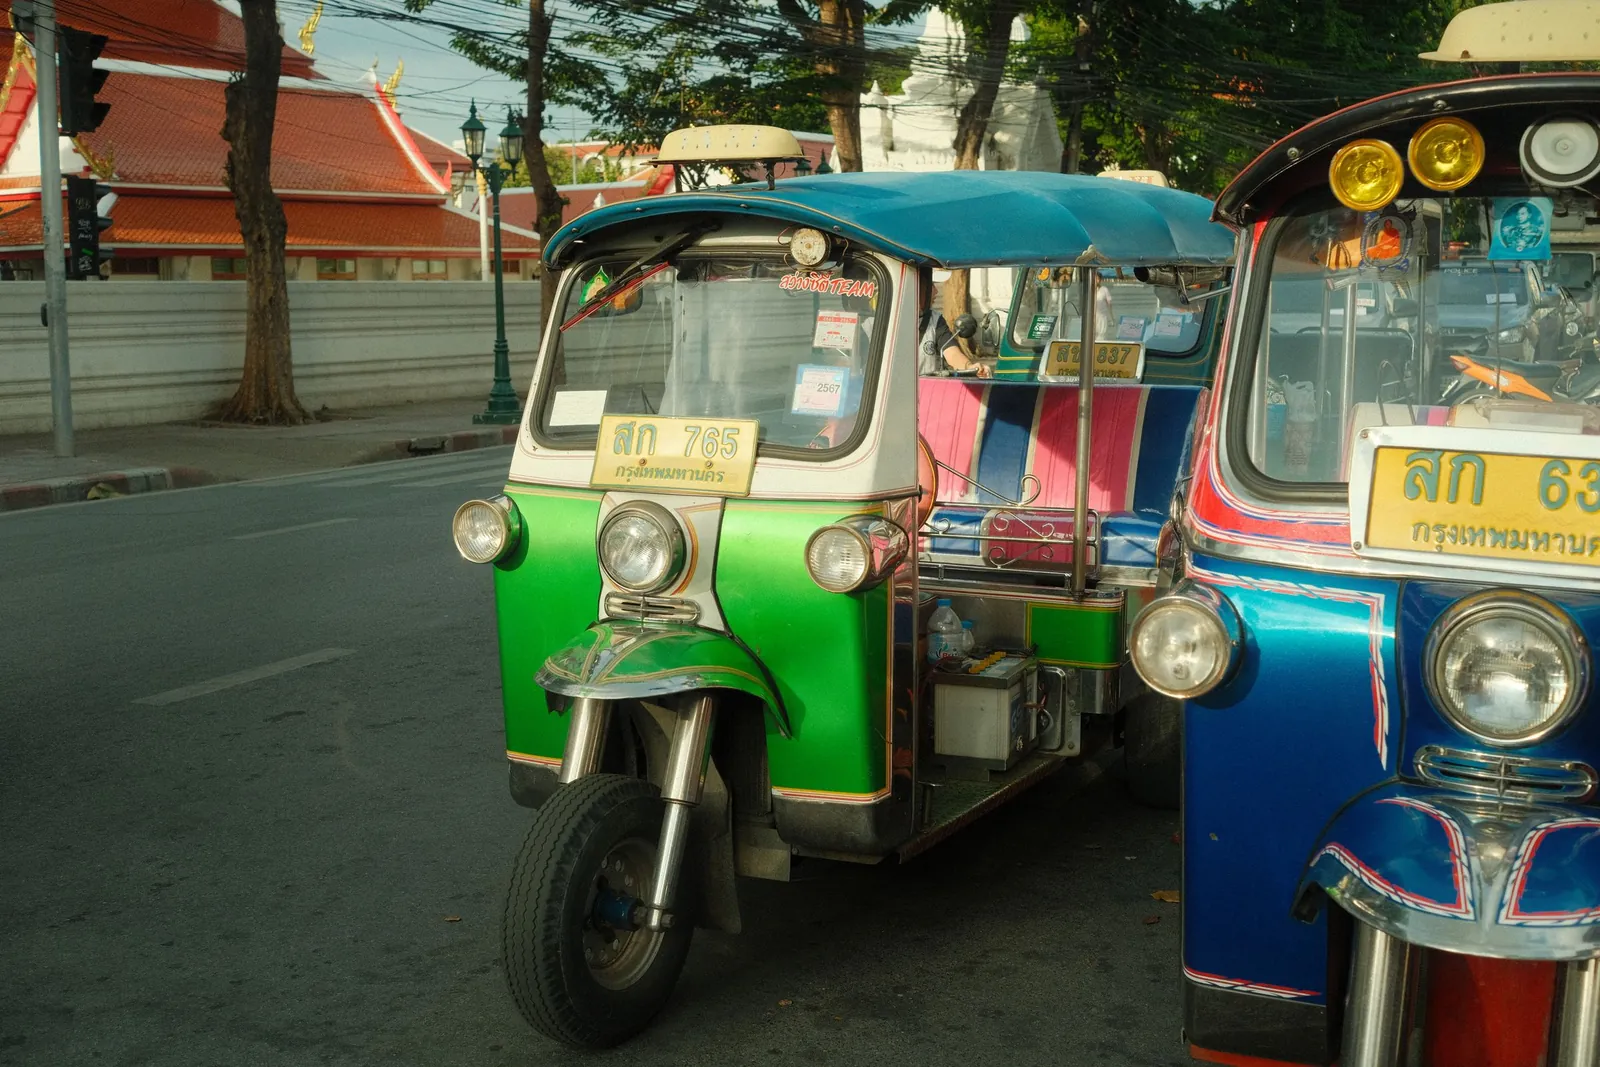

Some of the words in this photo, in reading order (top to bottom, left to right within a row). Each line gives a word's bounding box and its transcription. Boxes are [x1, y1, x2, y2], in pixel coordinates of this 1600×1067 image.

[1443, 267, 1479, 275] POLICE
[830, 278, 875, 298] TEAM
[1096, 346, 1132, 365] 837
[817, 383, 841, 395] 2567
[613, 421, 657, 456] สก
[684, 425, 740, 460] 765
[615, 465, 726, 484] กรุงเทพมหานคร
[1404, 450, 1486, 506] สก
[1538, 459, 1600, 513] 63
